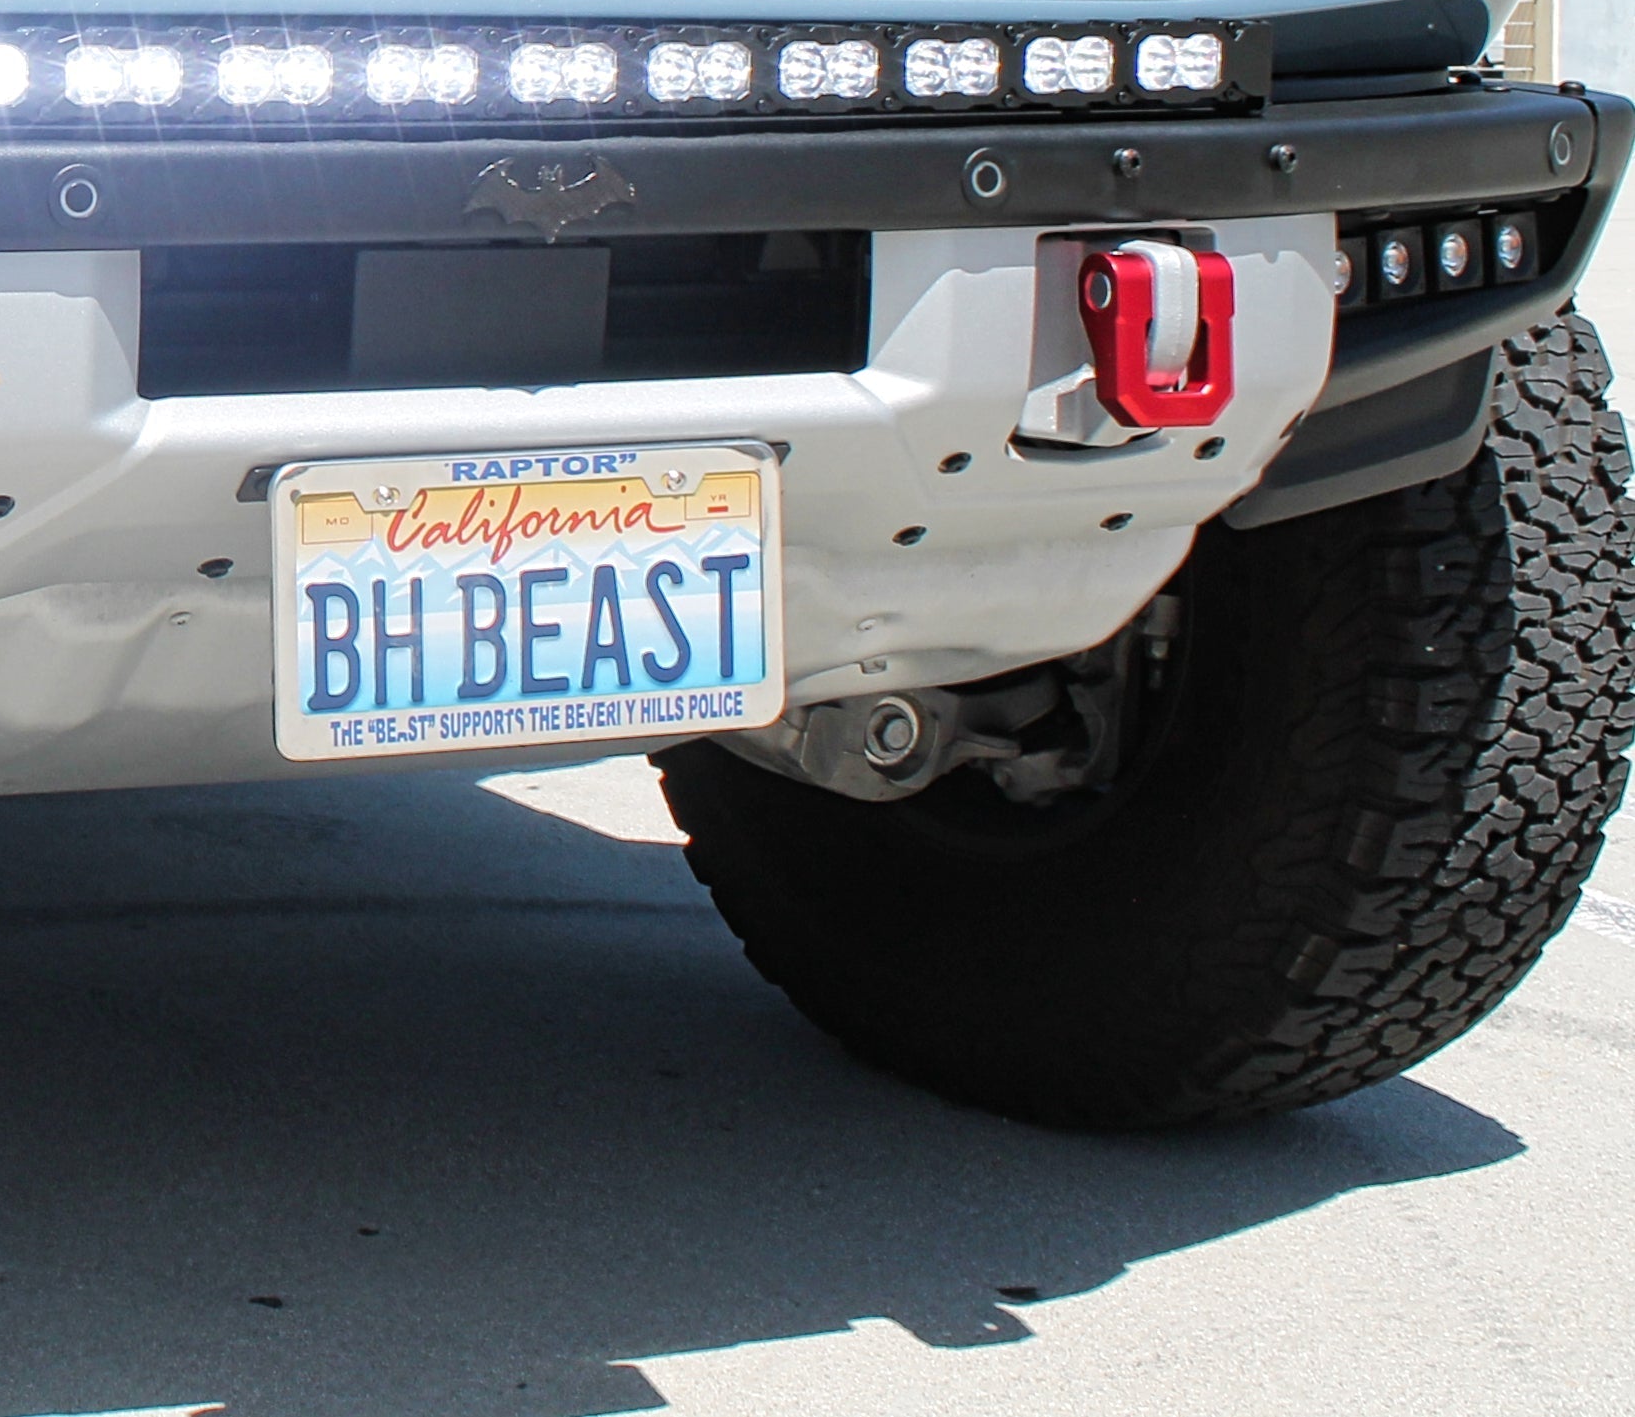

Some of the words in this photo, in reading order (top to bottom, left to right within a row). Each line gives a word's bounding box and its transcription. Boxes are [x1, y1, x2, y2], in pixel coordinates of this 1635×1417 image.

[325, 516, 350, 526] MO
[386, 484, 686, 565] California
[709, 494, 728, 502] YR
[305, 576, 425, 711] BH
[456, 553, 751, 699] BEAST
[329, 719, 364, 747] THE
[439, 707, 525, 740] SUPPORTS
[528, 705, 561, 733] THE
[640, 694, 685, 724] HILLS
[689, 690, 744, 720] POLICE
